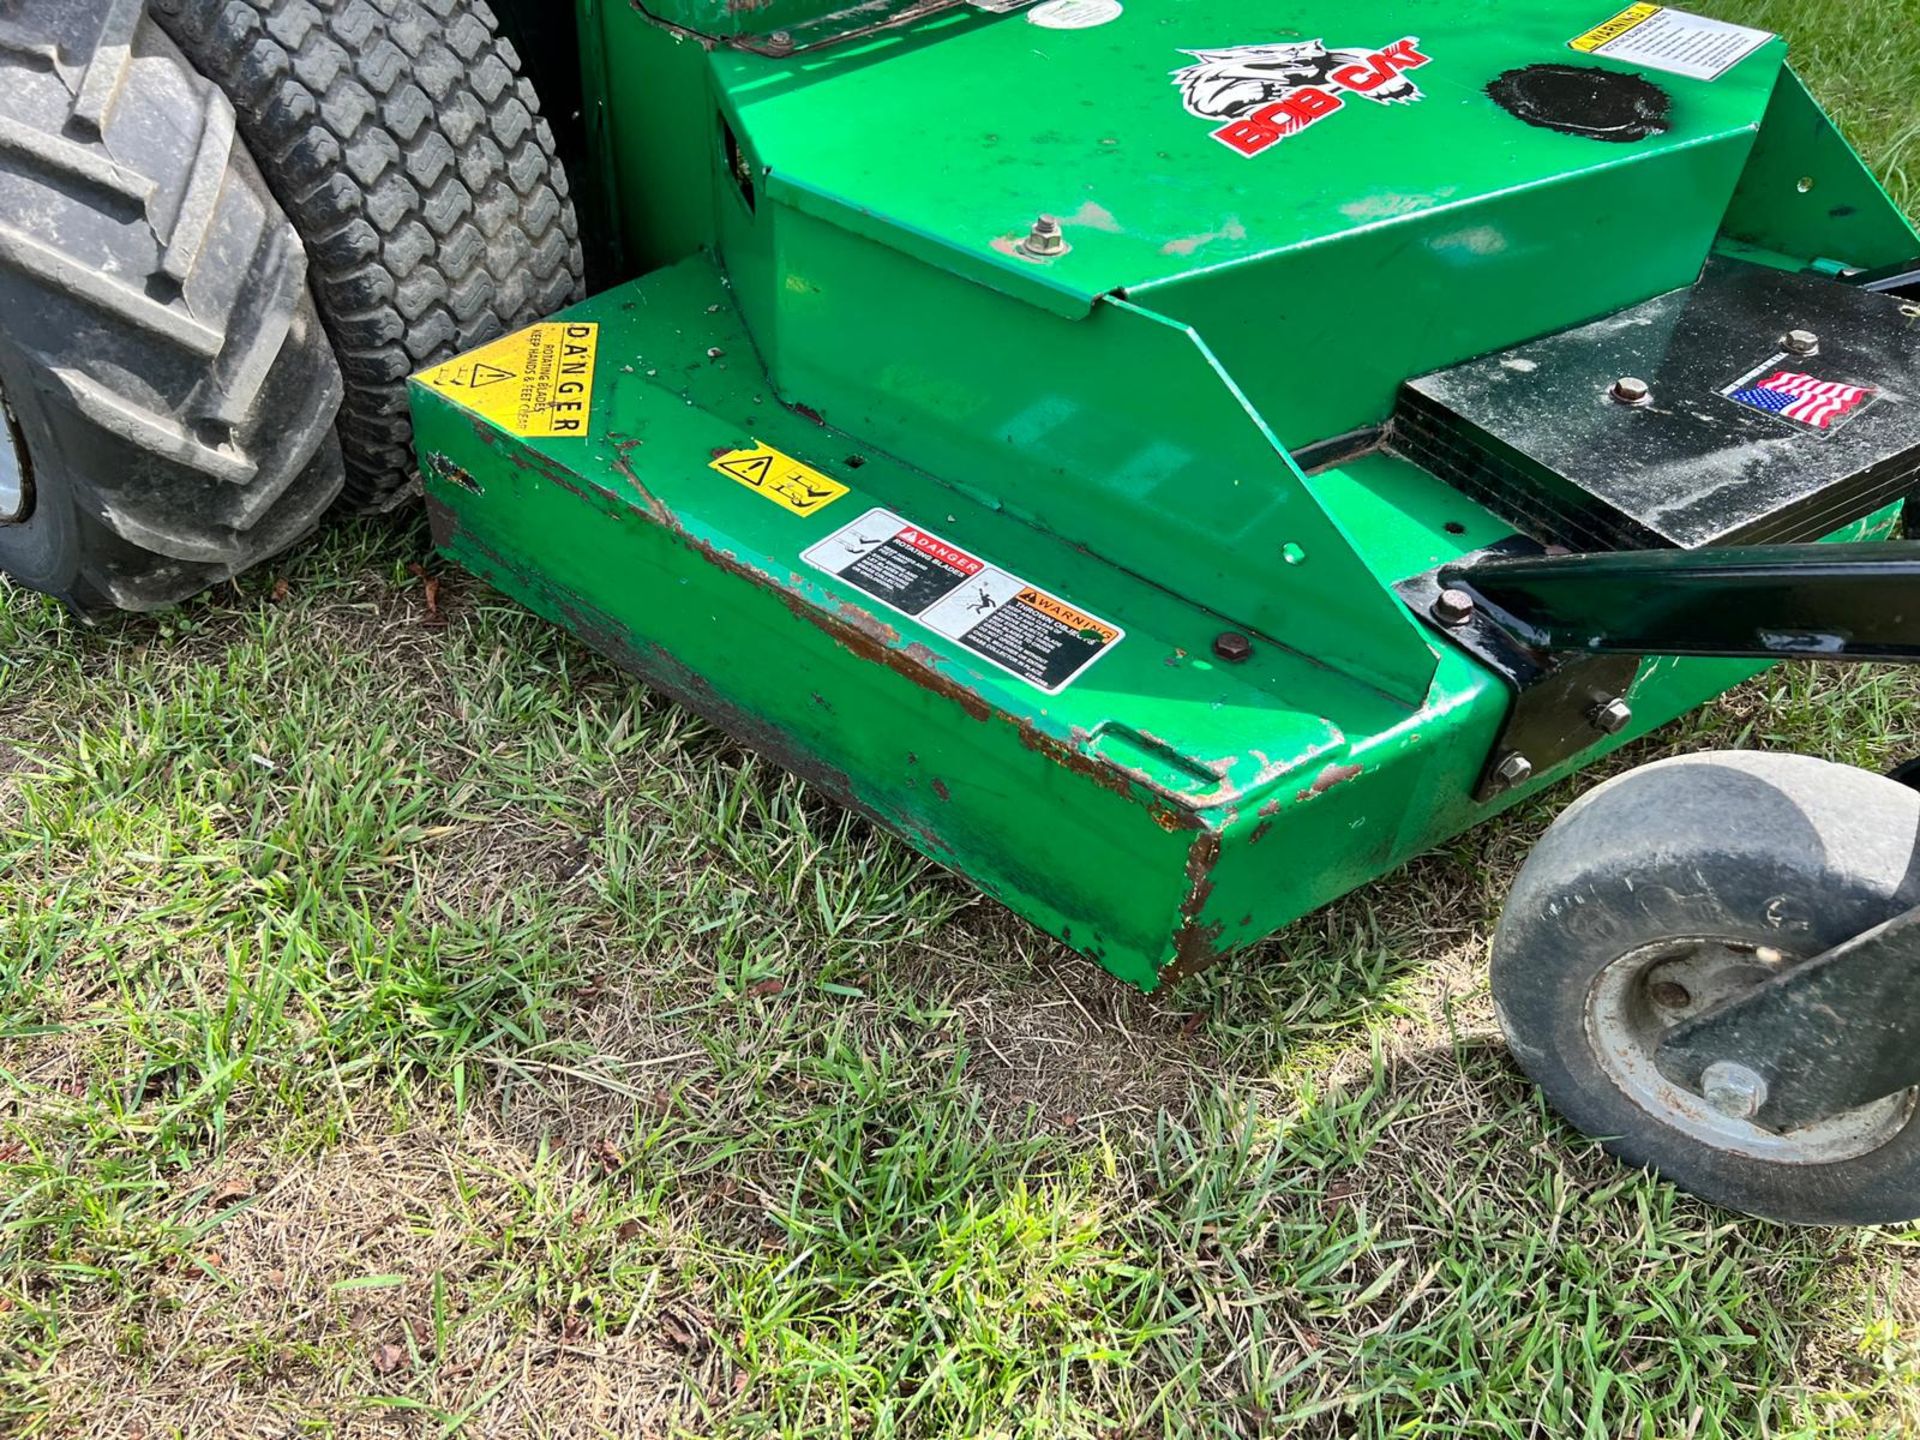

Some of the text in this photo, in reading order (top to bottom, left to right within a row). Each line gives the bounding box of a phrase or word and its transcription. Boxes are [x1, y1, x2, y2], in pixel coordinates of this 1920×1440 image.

[1589, 11, 1645, 42] WARNING
[1213, 39, 1430, 155] BOB-CAT
[529, 330, 542, 346] KEEP
[524, 348, 538, 373] HANDS
[533, 344, 554, 412] ROTATING BLADES
[554, 327, 589, 430] DANGER
[891, 537, 966, 577] ROTATING BLADES
[915, 537, 979, 572] DANGER
[1014, 601, 1055, 623] THROWN
[1036, 598, 1113, 640] WARNING
[985, 643, 1019, 662] COLLECTOR
